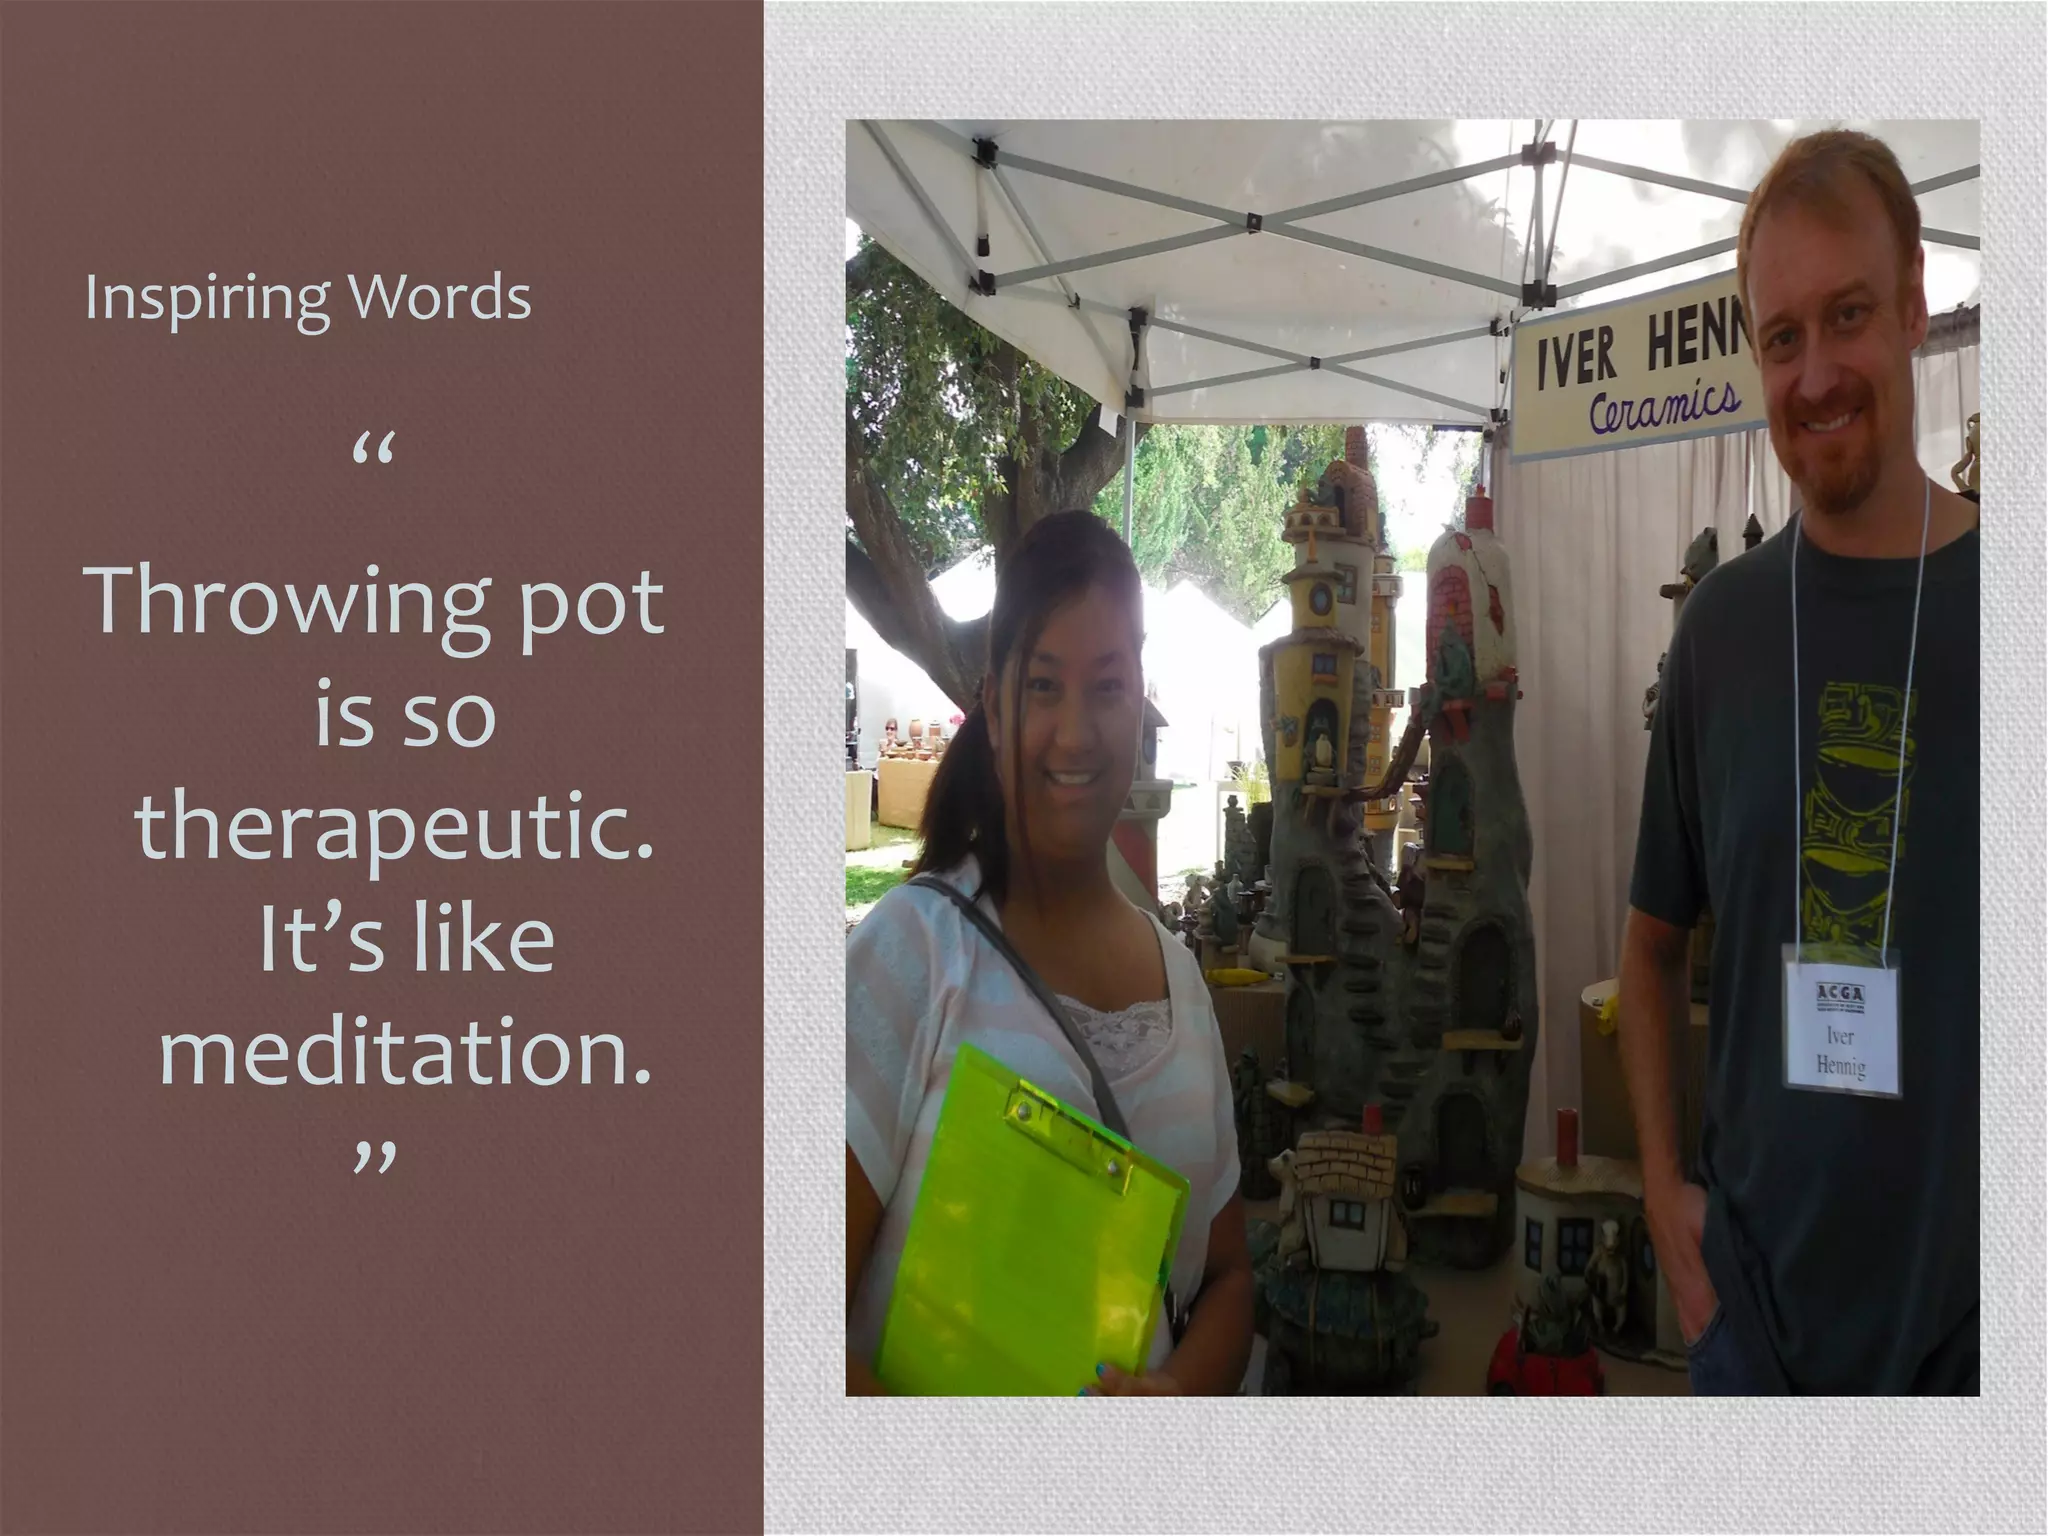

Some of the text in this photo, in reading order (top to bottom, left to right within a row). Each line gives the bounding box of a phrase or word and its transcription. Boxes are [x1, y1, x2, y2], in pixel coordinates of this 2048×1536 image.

[1538, 325, 1618, 391] IVER
[1590, 377, 1743, 434] Ceramics
[1818, 985, 1864, 1001] ACGA
[1827, 1025, 1855, 1045] Iver
[1817, 1054, 1866, 1082] Hennig
